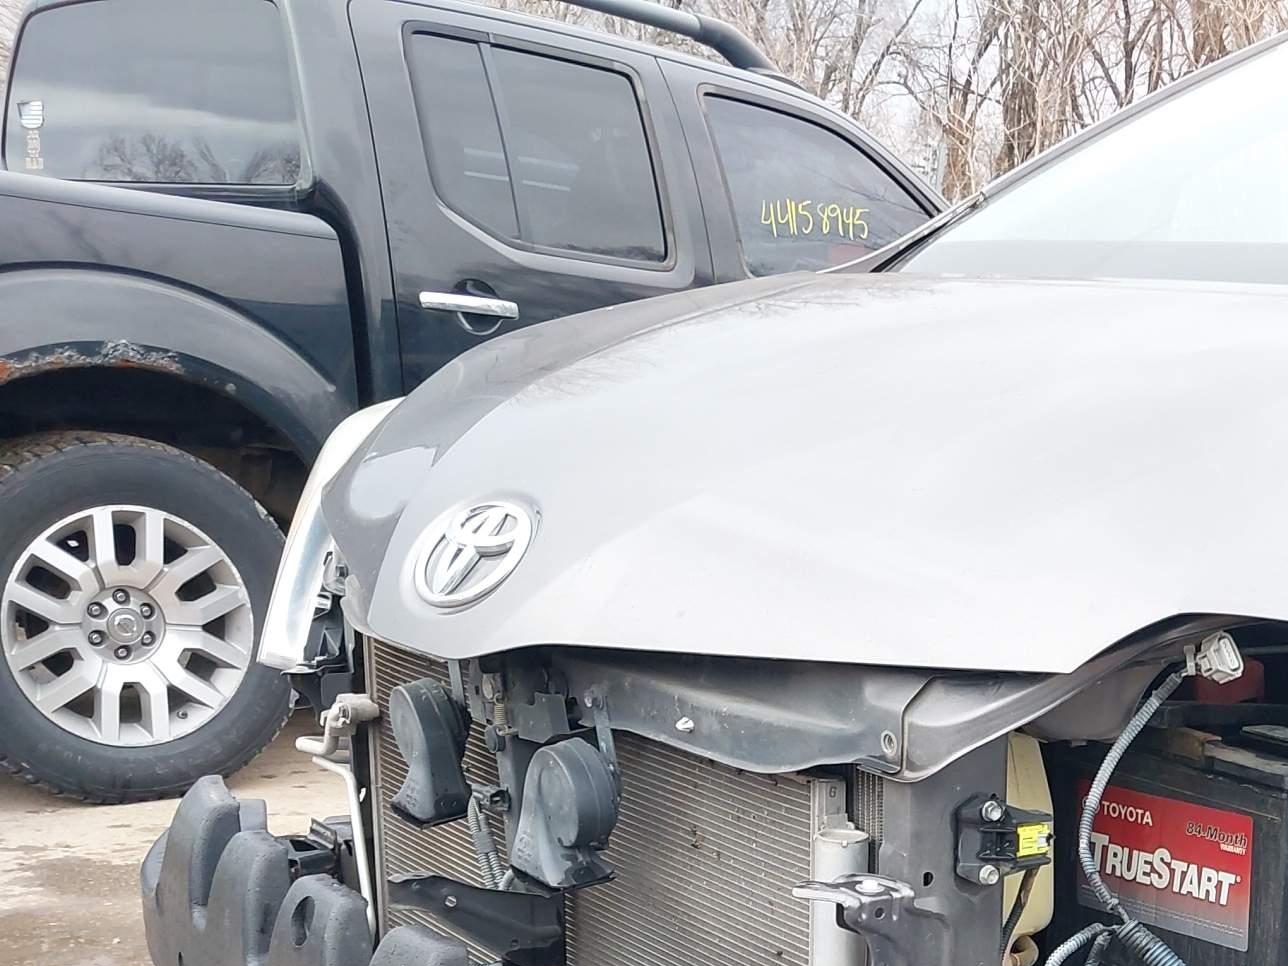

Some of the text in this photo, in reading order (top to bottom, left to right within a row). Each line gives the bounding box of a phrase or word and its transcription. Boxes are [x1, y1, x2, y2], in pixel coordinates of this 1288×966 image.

[761, 198, 870, 240] 44158945
[1102, 801, 1153, 827] TOYOTA
[1185, 820, 1248, 849] 84-Month
